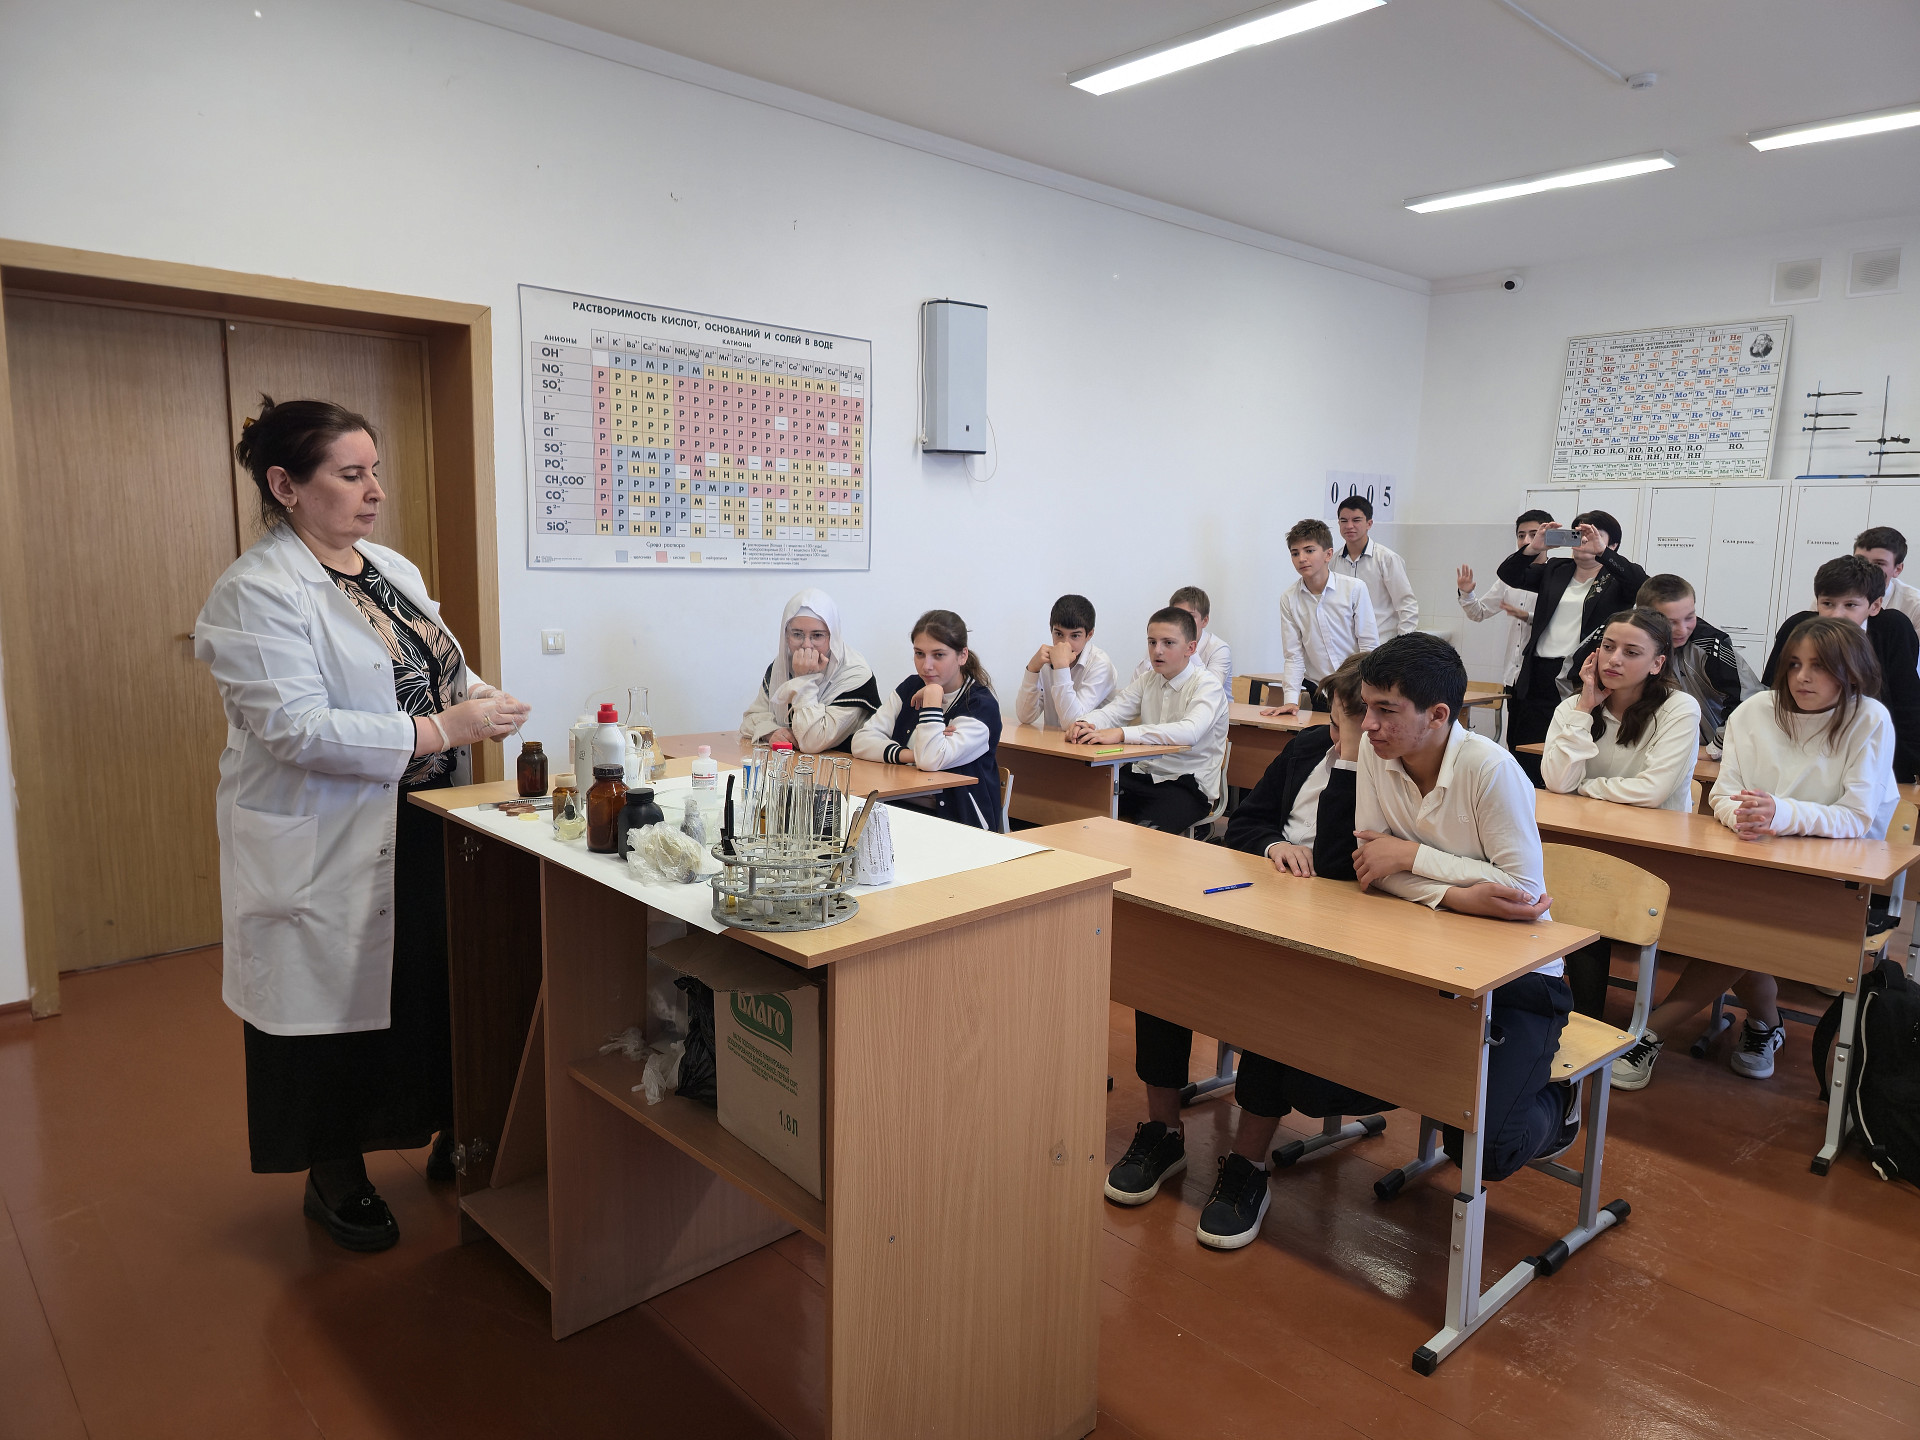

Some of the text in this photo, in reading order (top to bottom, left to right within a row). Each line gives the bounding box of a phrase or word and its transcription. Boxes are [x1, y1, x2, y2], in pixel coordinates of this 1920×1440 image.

[573, 302, 656, 322] РАСТВОРИМОСТЬ
[662, 315, 701, 331] КИСЛОТ,
[705, 323, 760, 338] ОСНОВАНИЙ
[775, 333, 801, 344] СОЛЕЙ
[814, 339, 833, 349] ВОДЕ
[544, 335, 577, 344] АНИОНЫ
[723, 339, 751, 348] КАТИОНЫ
